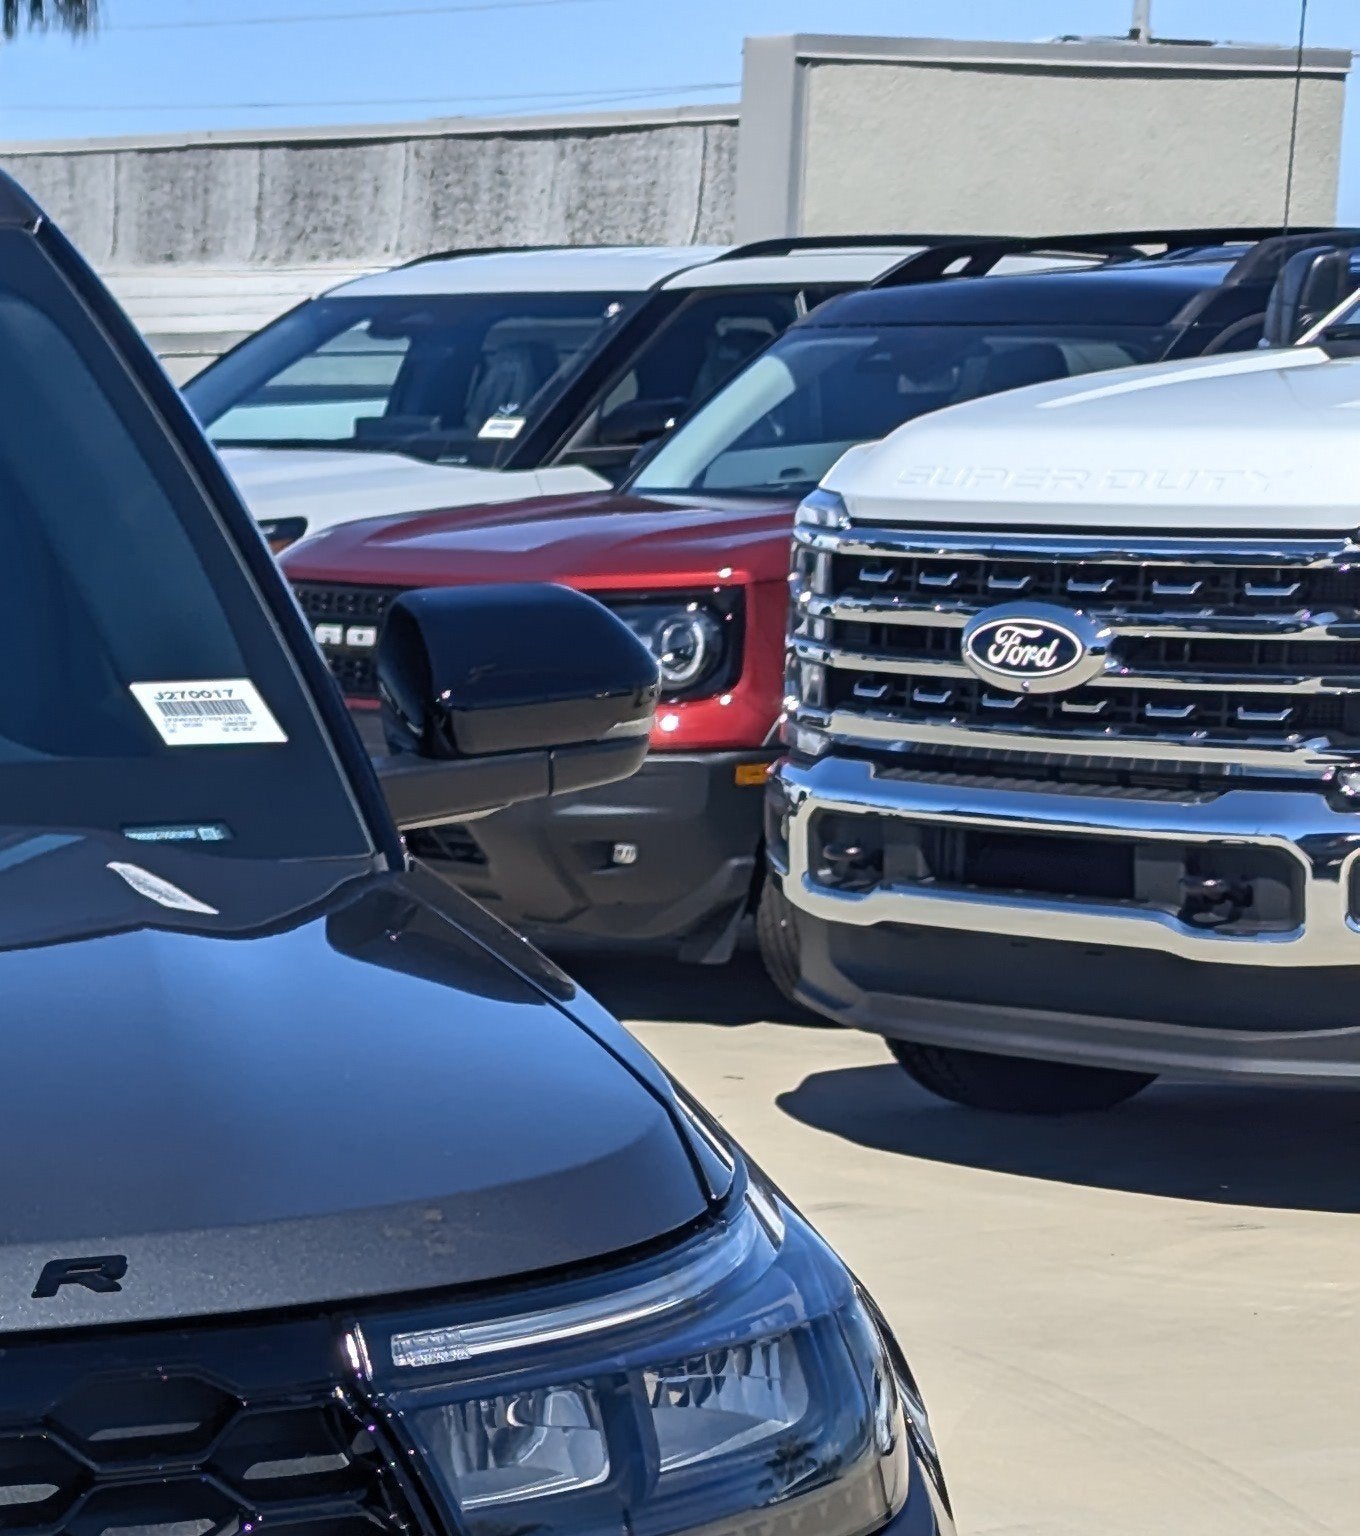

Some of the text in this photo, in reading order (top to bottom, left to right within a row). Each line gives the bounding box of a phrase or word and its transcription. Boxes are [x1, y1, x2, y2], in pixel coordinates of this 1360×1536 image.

[894, 464, 1294, 493] SUPER DUTY
[987, 625, 1060, 668] Ford
[154, 688, 234, 701] J270017
